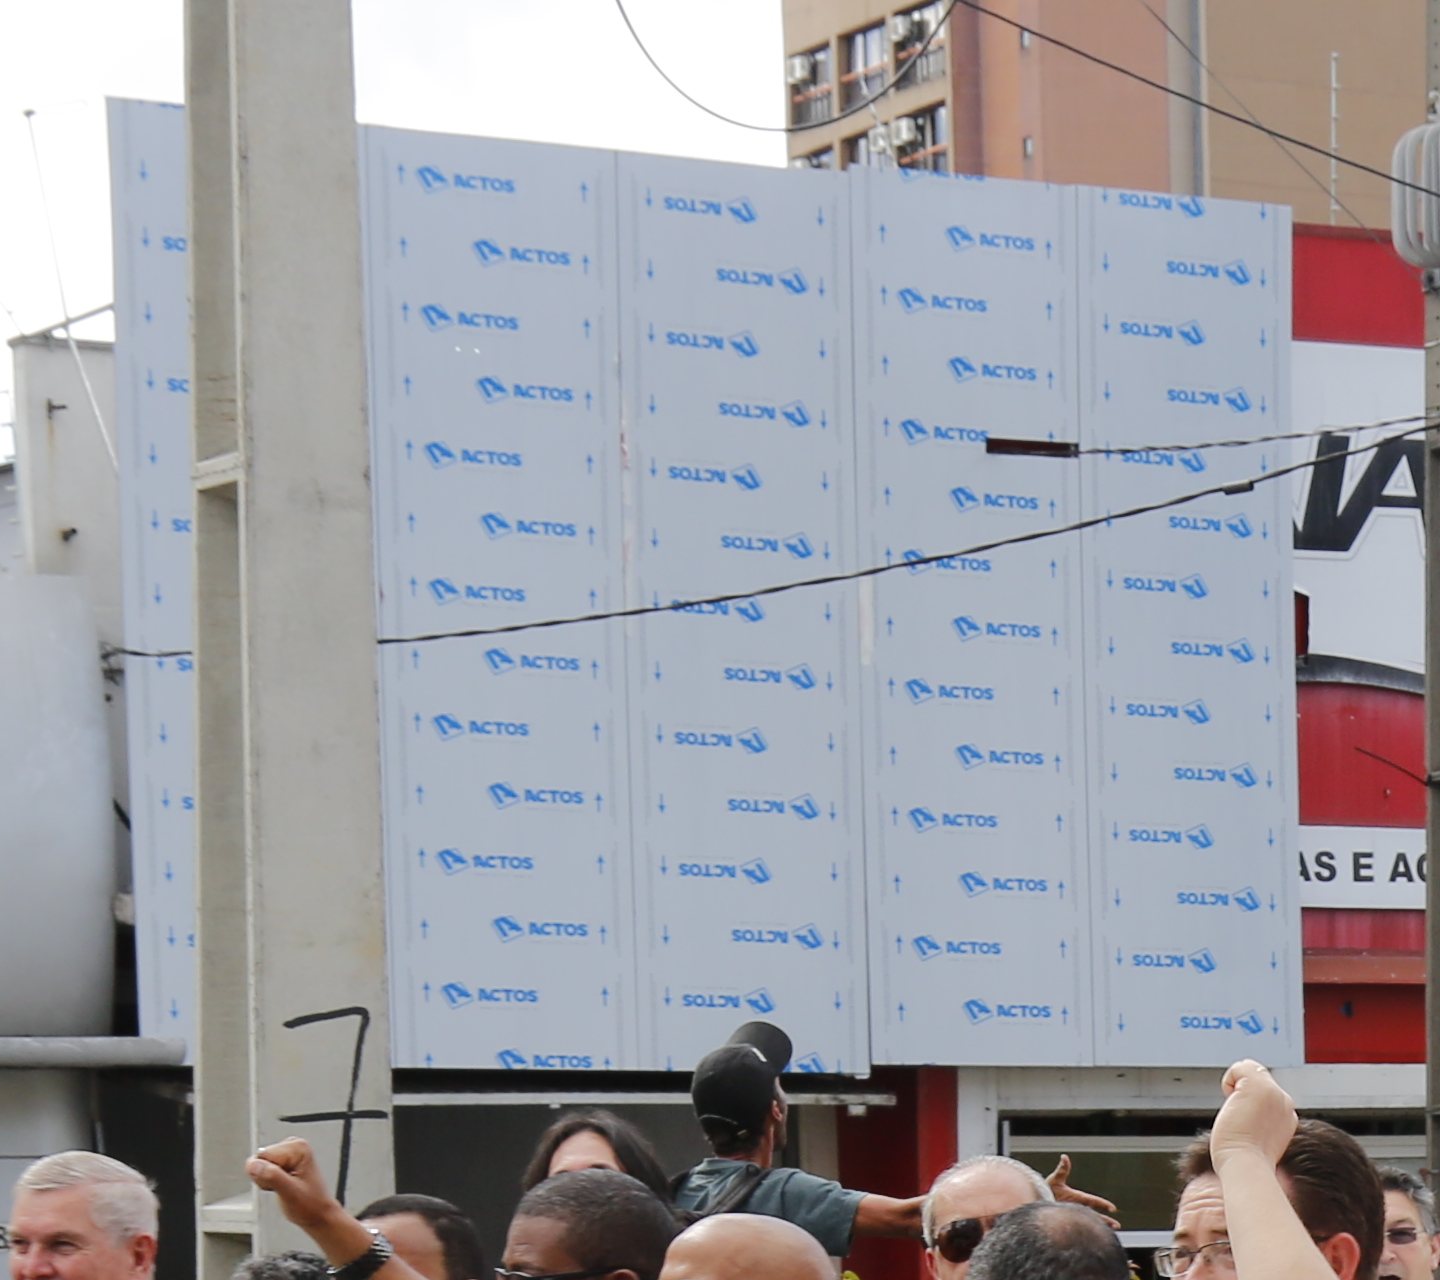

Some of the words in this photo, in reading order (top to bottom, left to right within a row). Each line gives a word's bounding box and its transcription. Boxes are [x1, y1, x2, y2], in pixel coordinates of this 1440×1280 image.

[453, 174, 516, 193] ACTOS
[664, 197, 725, 216] ACTOS
[1119, 194, 1174, 211] ACTOS
[979, 233, 1036, 251] ACTOS
[508, 247, 572, 267] ACTOS
[717, 268, 775, 288] ACTOS
[1167, 261, 1223, 279] ACTOS
[930, 295, 988, 313] ACTOS
[456, 311, 520, 331] ACTOS
[1120, 322, 1175, 340] ACTOS
[666, 332, 726, 351] ACTOS
[981, 363, 1037, 382] ACTOS
[513, 384, 574, 402] ACTOS
[1168, 390, 1221, 406] ACTOS
[719, 403, 777, 421] ACTOS
[933, 425, 989, 443] ACTOS
[459, 448, 523, 468] ACTOS
[668, 467, 728, 484] ACTOS
[983, 493, 1040, 510] ACTOS
[515, 520, 577, 538] ACTOS
[1169, 516, 1223, 533] ACTOS
[721, 535, 781, 553] ACTOS
[1123, 577, 1178, 593] ACTOS
[464, 585, 527, 603] ACTOS
[985, 623, 1041, 638] ACTOS
[1171, 642, 1225, 657] ACTOS
[520, 656, 580, 672] ACTOS
[724, 668, 783, 684] ACTOS
[938, 685, 994, 700] ACTOS
[1126, 704, 1182, 719] ACTOS
[469, 720, 530, 736] ACTOS
[675, 732, 734, 748] ACTOS
[988, 751, 1044, 765] ACTOS
[1174, 768, 1230, 782] ACTOS
[524, 788, 586, 805] ACTOS
[728, 800, 787, 814] ACTOS
[942, 813, 999, 828] ACTOS
[1130, 829, 1183, 844] ACTOS
[472, 855, 535, 870] ACTOS
[1353, 852, 1375, 882] E
[679, 864, 738, 878] ACTOS
[993, 879, 1048, 892] ACTOS
[1178, 892, 1231, 906] ACTOS
[528, 922, 589, 938] ACTOS
[732, 929, 790, 944] ACTOS
[946, 941, 1002, 956] ACTOS
[1132, 954, 1186, 968] ACTOS
[478, 988, 539, 1004] ACTOS
[683, 994, 742, 1008] ACTOS
[996, 1004, 1052, 1019] ACTOS
[1180, 1016, 1233, 1030] ACTOS
[533, 1055, 593, 1068] ACTOS
